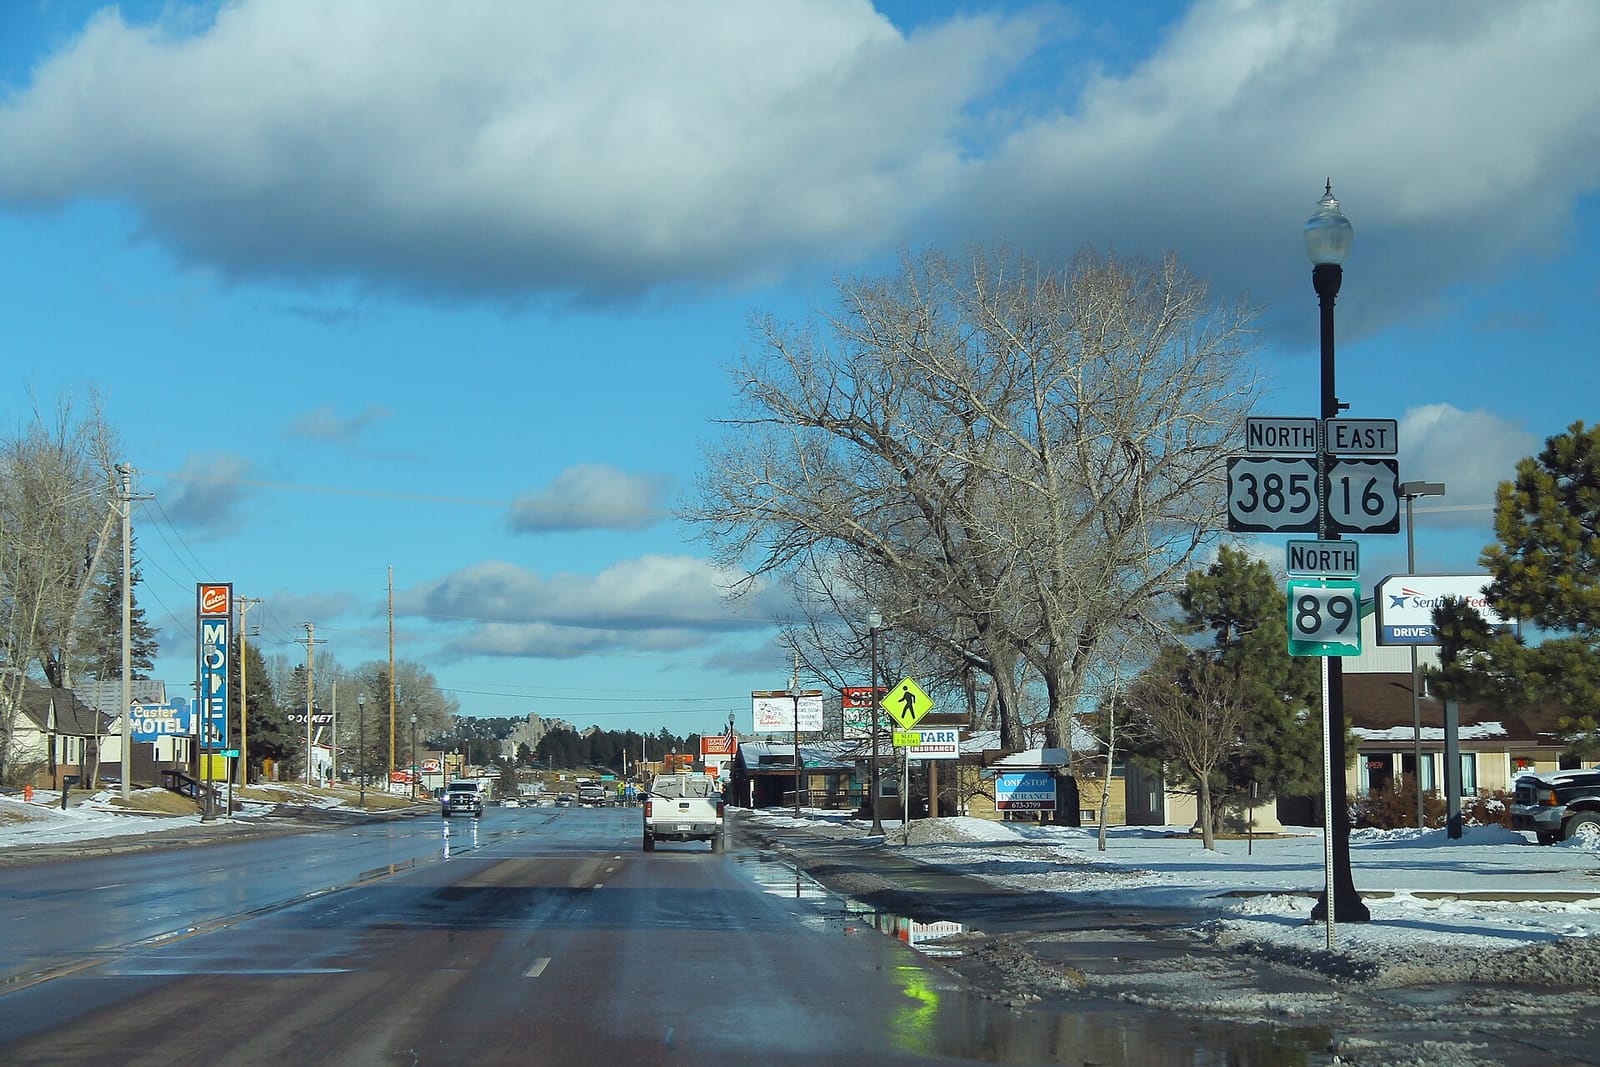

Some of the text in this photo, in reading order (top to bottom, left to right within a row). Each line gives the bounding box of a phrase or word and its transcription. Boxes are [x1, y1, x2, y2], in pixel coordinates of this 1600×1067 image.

[1249, 420, 1315, 448] NORTH
[1336, 425, 1387, 449] EAST
[1236, 472, 1311, 514] 385
[1340, 476, 1384, 516] 16
[1290, 546, 1356, 571] NORTH
[1296, 594, 1354, 635] 89
[134, 705, 178, 718] Custer
[130, 717, 186, 734] MOTEL
[911, 745, 954, 753] INSURANCE
[1003, 779, 1047, 787] ONE-STOP
